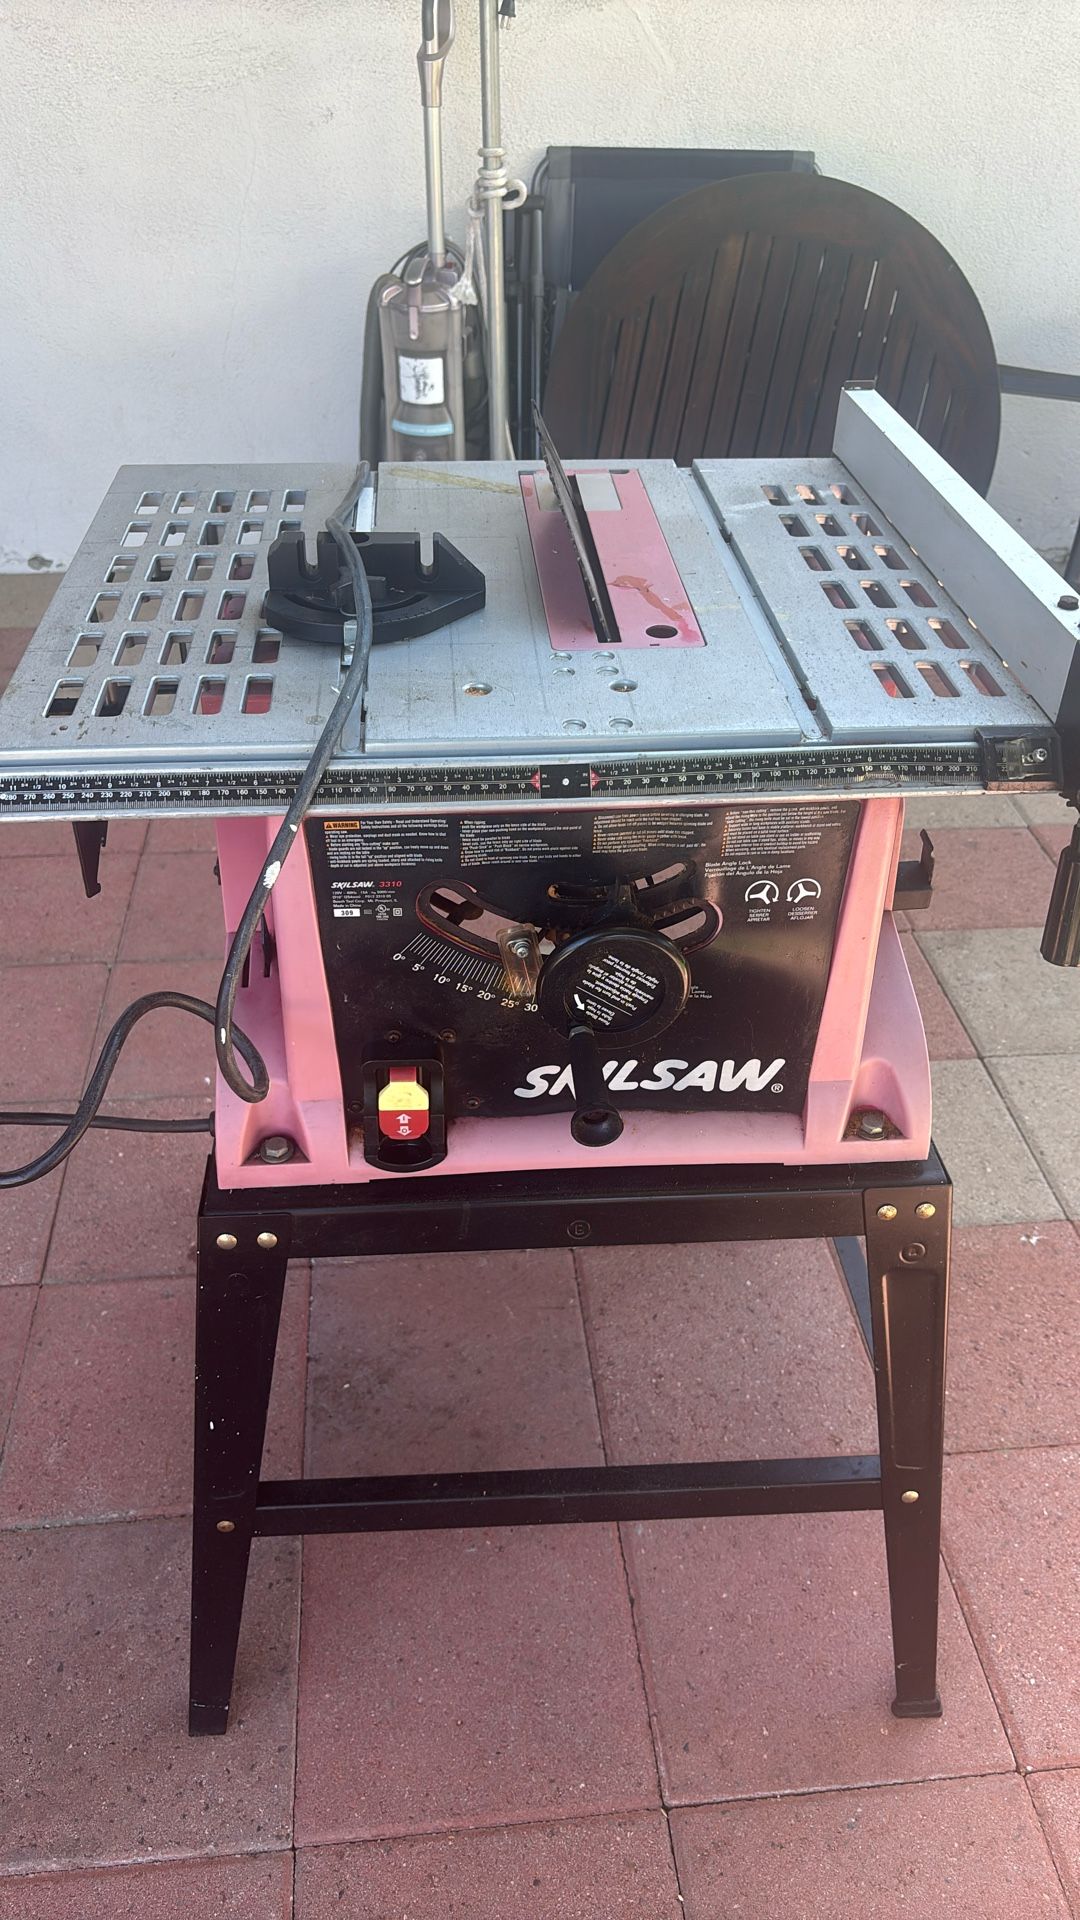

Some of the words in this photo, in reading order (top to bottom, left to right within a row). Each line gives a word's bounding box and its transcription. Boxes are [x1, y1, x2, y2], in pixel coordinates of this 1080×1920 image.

[330, 881, 374, 890] SKILSAW
[412, 963, 425, 972] 5°
[433, 974, 450, 984] 10°
[455, 982, 473, 993] 15°
[477, 990, 496, 1001] 20°
[500, 998, 520, 1008] 25°
